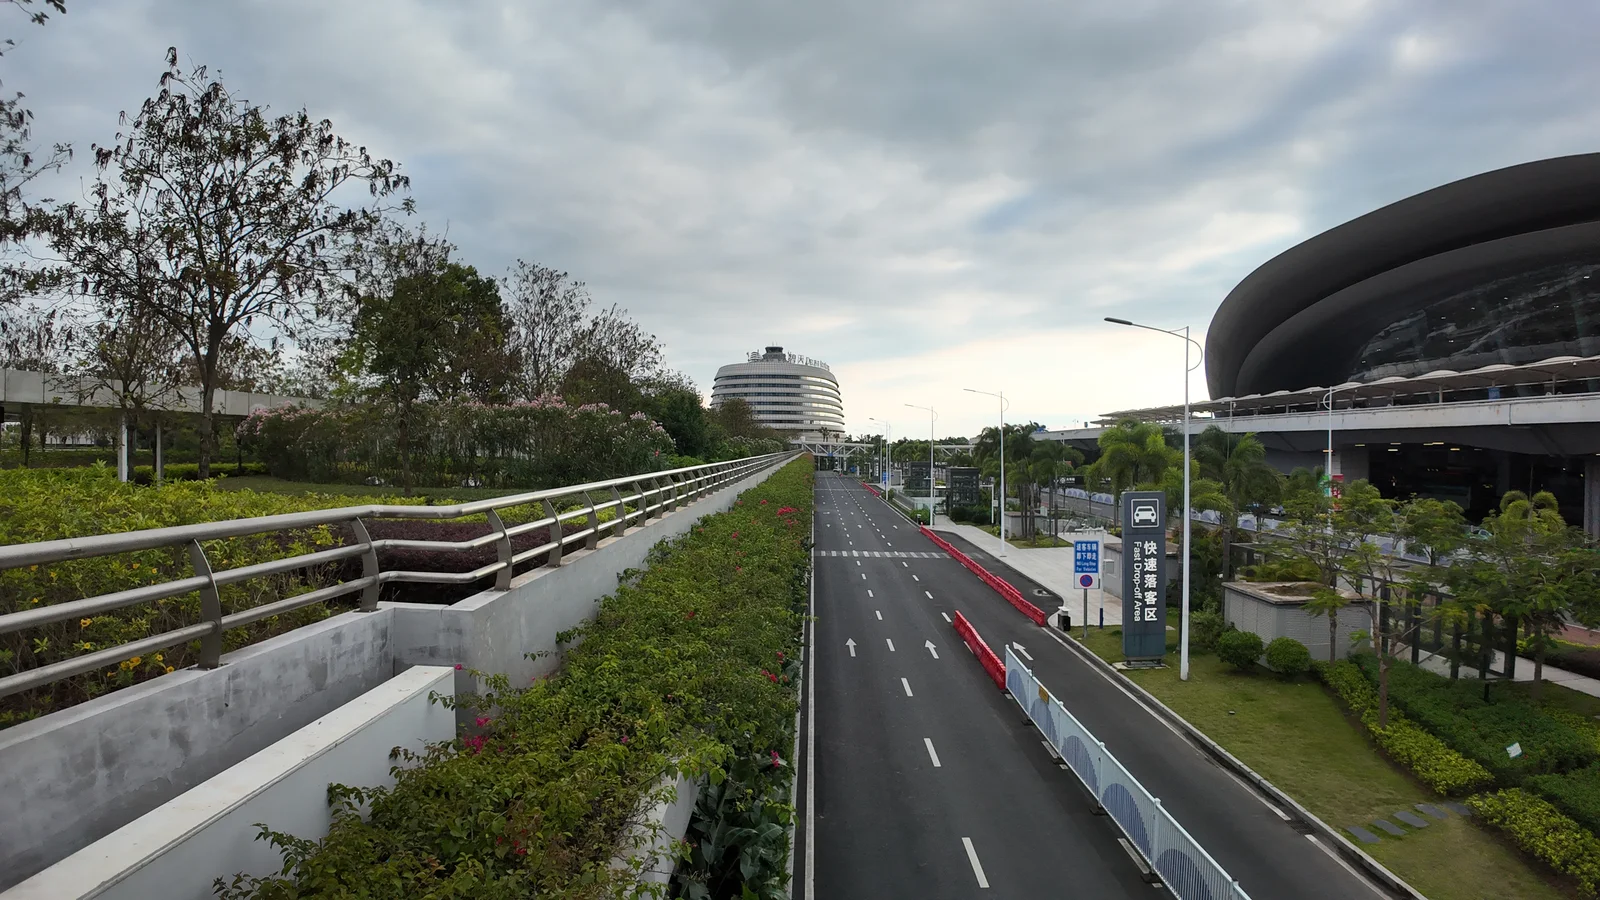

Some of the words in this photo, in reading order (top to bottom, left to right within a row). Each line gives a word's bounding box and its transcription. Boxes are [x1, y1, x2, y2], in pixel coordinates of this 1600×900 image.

[1076, 552, 1097, 560] 即下即走
[1133, 541, 1142, 561] Fast
[1132, 563, 1143, 599] Drop-off
[1143, 540, 1158, 621] 快速落客区
[1133, 600, 1142, 622] Area
